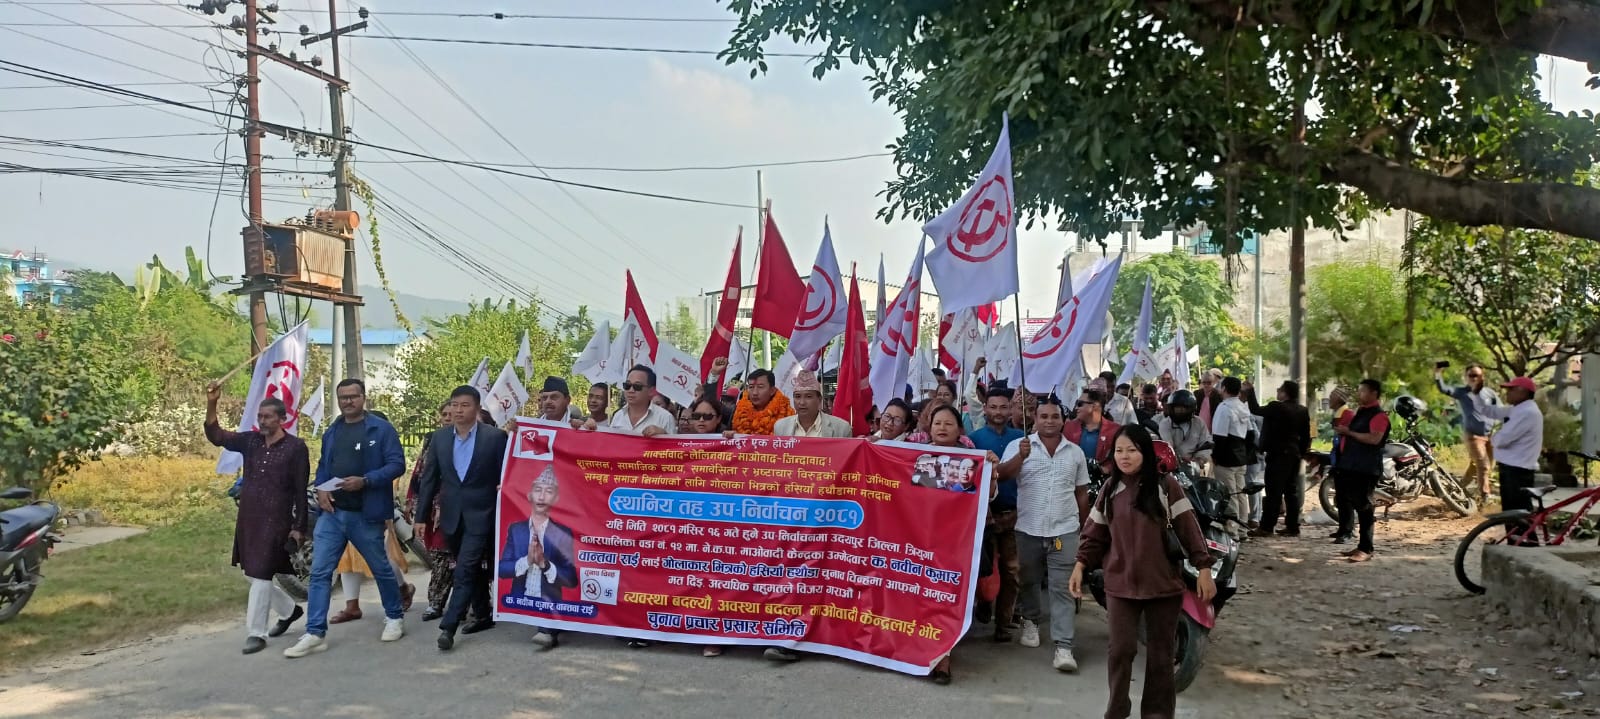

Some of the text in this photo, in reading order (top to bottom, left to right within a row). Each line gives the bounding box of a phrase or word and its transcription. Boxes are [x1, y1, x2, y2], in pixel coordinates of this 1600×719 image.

[751, 438, 767, 449] एक
[614, 474, 639, 484] समाज
[641, 474, 681, 486] निर्माणको
[685, 476, 706, 488] लागि
[749, 480, 780, 492] भित्रको
[860, 489, 892, 501] मतदान
[617, 461, 657, 472] सामाजिक
[742, 467, 750, 477] र
[841, 472, 861, 482] हाम्रो
[865, 474, 901, 488] अभियान
[613, 492, 858, 525] स्थानिय तह उप-निर्वाचन २०८१
[606, 518, 624, 531] यहि
[626, 519, 647, 532] मिति
[652, 523, 676, 534] २०८१
[708, 527, 720, 537] १६
[724, 527, 739, 539] गते
[742, 528, 759, 541] हुने
[831, 533, 864, 548] उदयपुर
[868, 537, 900, 552] जिल्ला
[581, 535, 635, 547] नगरपालिका
[639, 540, 654, 549] वडा
[670, 543, 682, 551] १२
[740, 545, 784, 559] माओवादी
[787, 547, 824, 560] केन्द्रका
[827, 550, 869, 567] उम्मेदवार
[870, 555, 887, 569] क.
[890, 558, 923, 577] नवीन
[925, 565, 962, 585] कुमार
[620, 552, 640, 568] राई
[641, 557, 660, 568] लाई
[662, 555, 711, 572] गोलाकार
[712, 559, 748, 575] भित्रको
[821, 569, 845, 581] चुनाव
[668, 575, 684, 586] मत
[708, 579, 750, 591] अत्यधिक
[753, 582, 794, 595] बहुमतले
[796, 582, 823, 594] विजय
[535, 600, 555, 611] कुमार
[623, 591, 669, 606] व्यवस्था
[718, 599, 760, 614] अवस्था
[810, 602, 858, 622] माओवादी
[860, 609, 917, 636] केन्द्रलाई
[918, 622, 943, 640] भोट
[647, 611, 807, 638] चुनाव प्रचार प्रसार समिति
